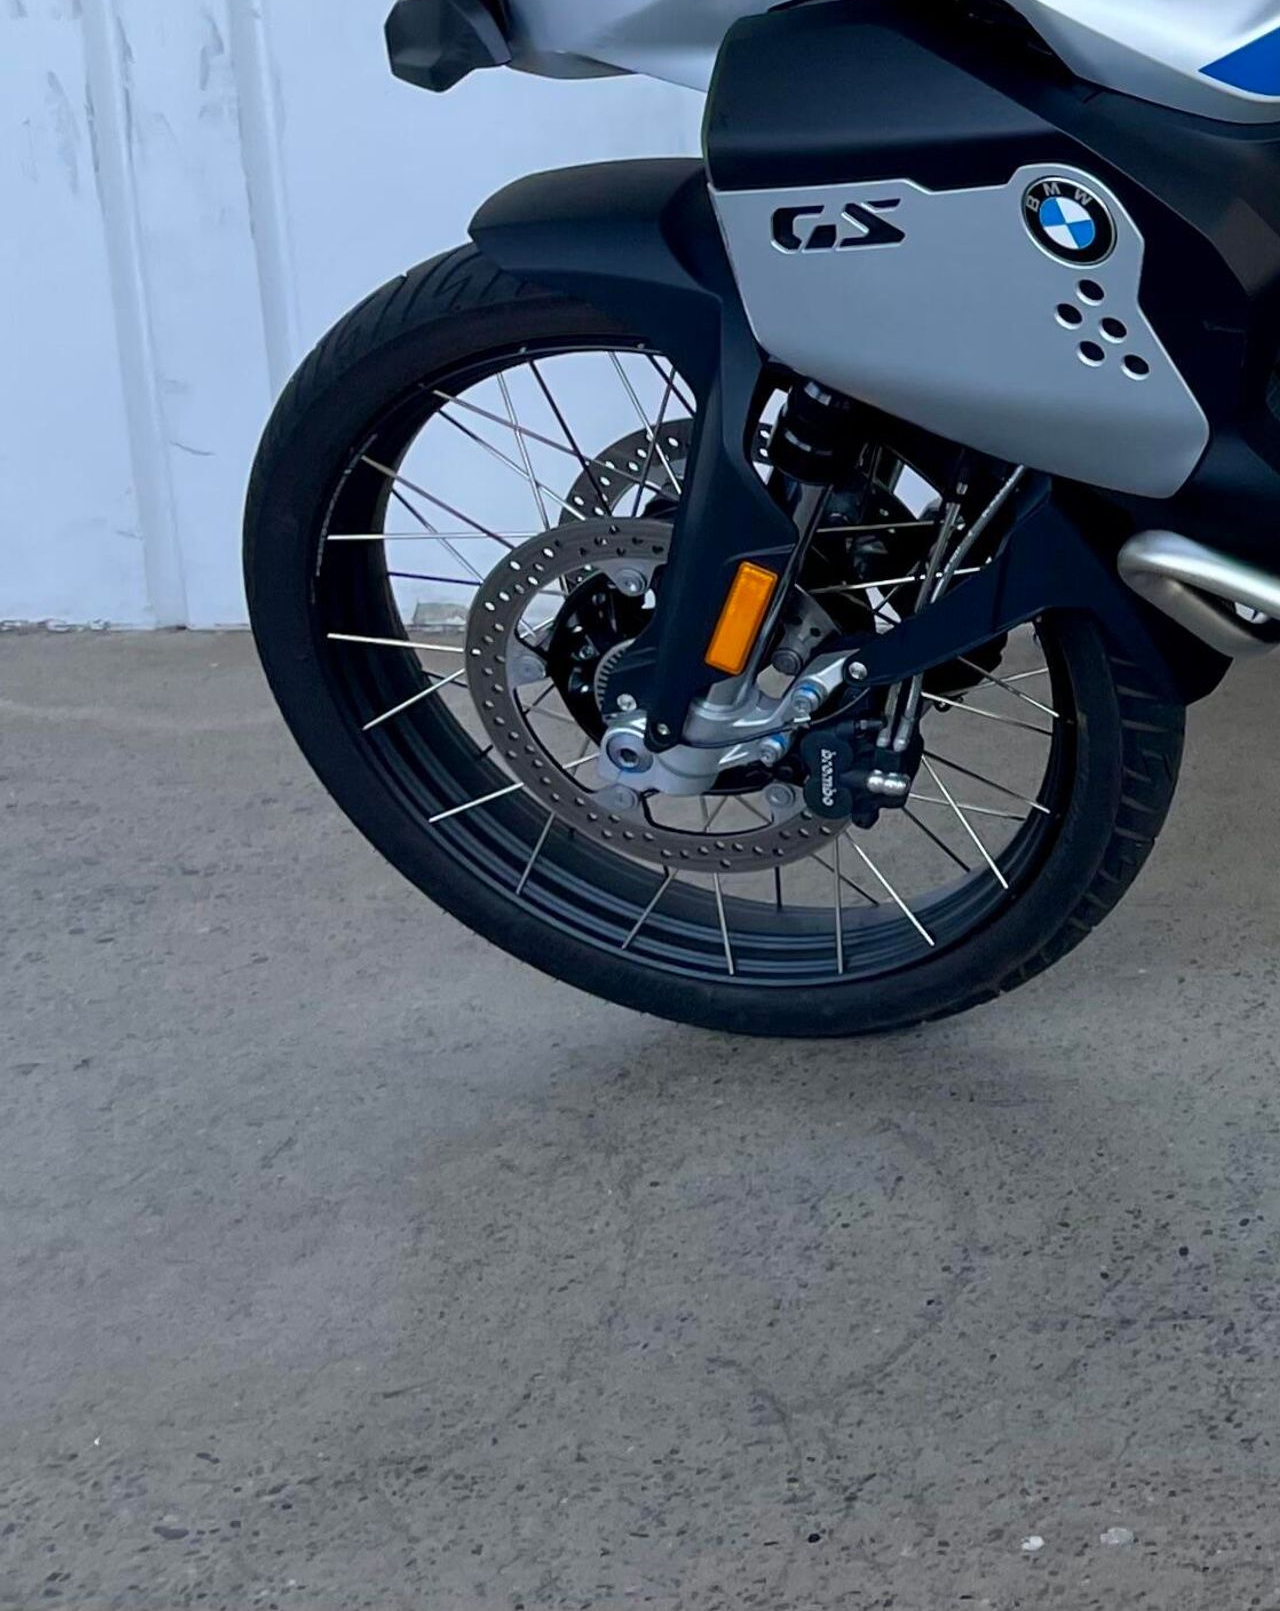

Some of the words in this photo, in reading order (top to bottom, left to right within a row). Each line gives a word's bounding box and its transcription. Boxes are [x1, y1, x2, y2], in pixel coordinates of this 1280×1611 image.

[770, 197, 906, 252] GS
[1025, 181, 1093, 213] BMW
[820, 748, 837, 807] brembo
